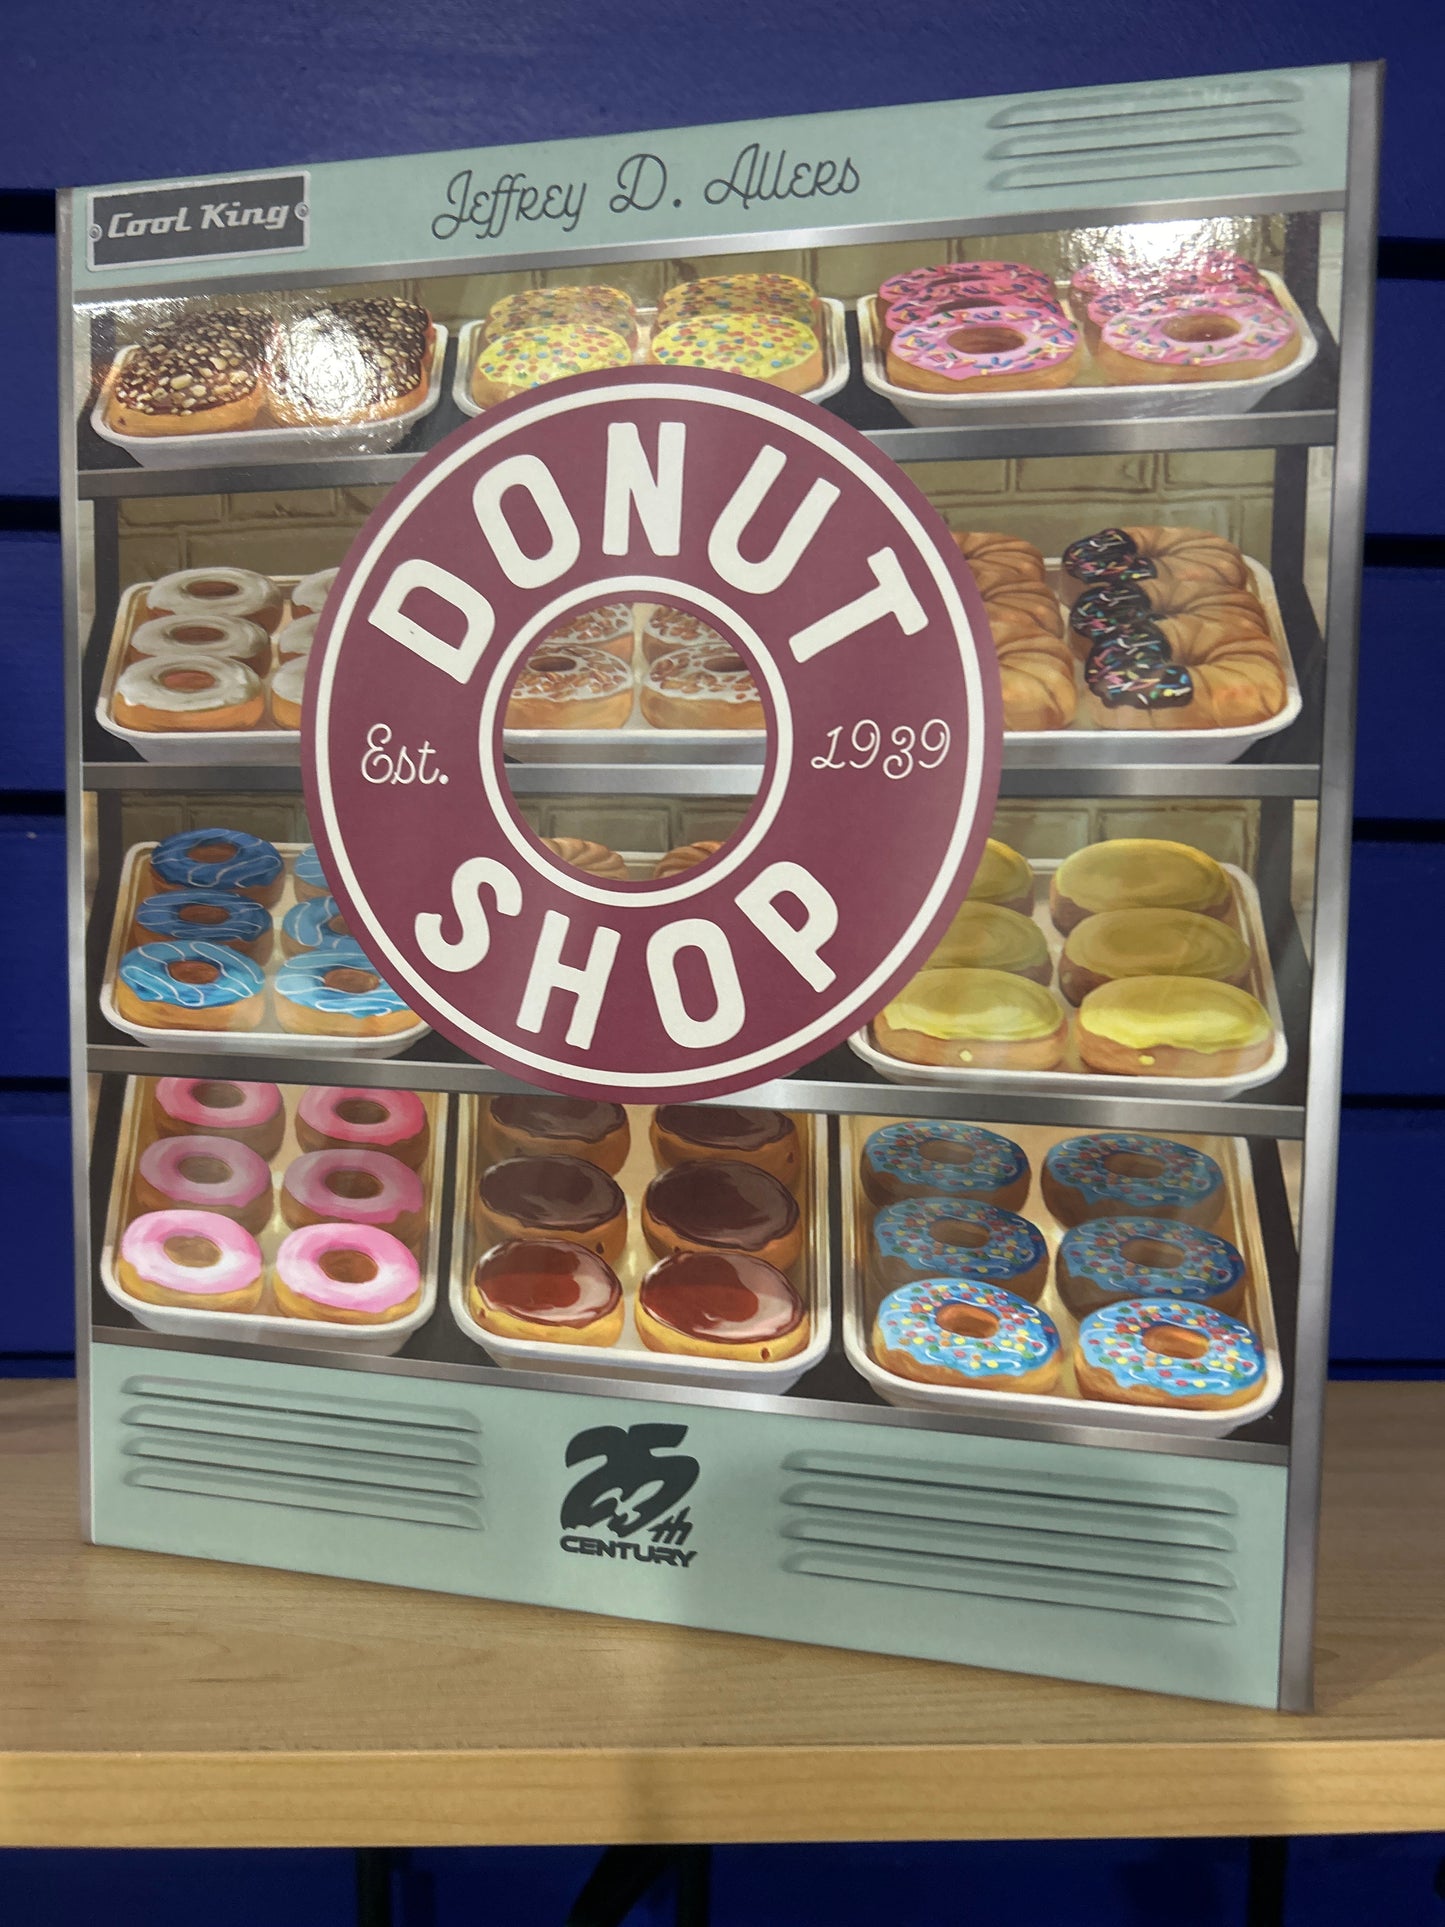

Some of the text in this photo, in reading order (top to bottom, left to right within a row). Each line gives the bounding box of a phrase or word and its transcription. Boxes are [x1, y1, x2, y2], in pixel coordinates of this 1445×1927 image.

[608, 153, 682, 214] D.
[107, 201, 290, 239] Cool King
[368, 421, 929, 684] DONUT
[360, 718, 952, 785] Est. 1939
[414, 855, 839, 1051] SHOP
[559, 1534, 698, 1568] CENTURY
